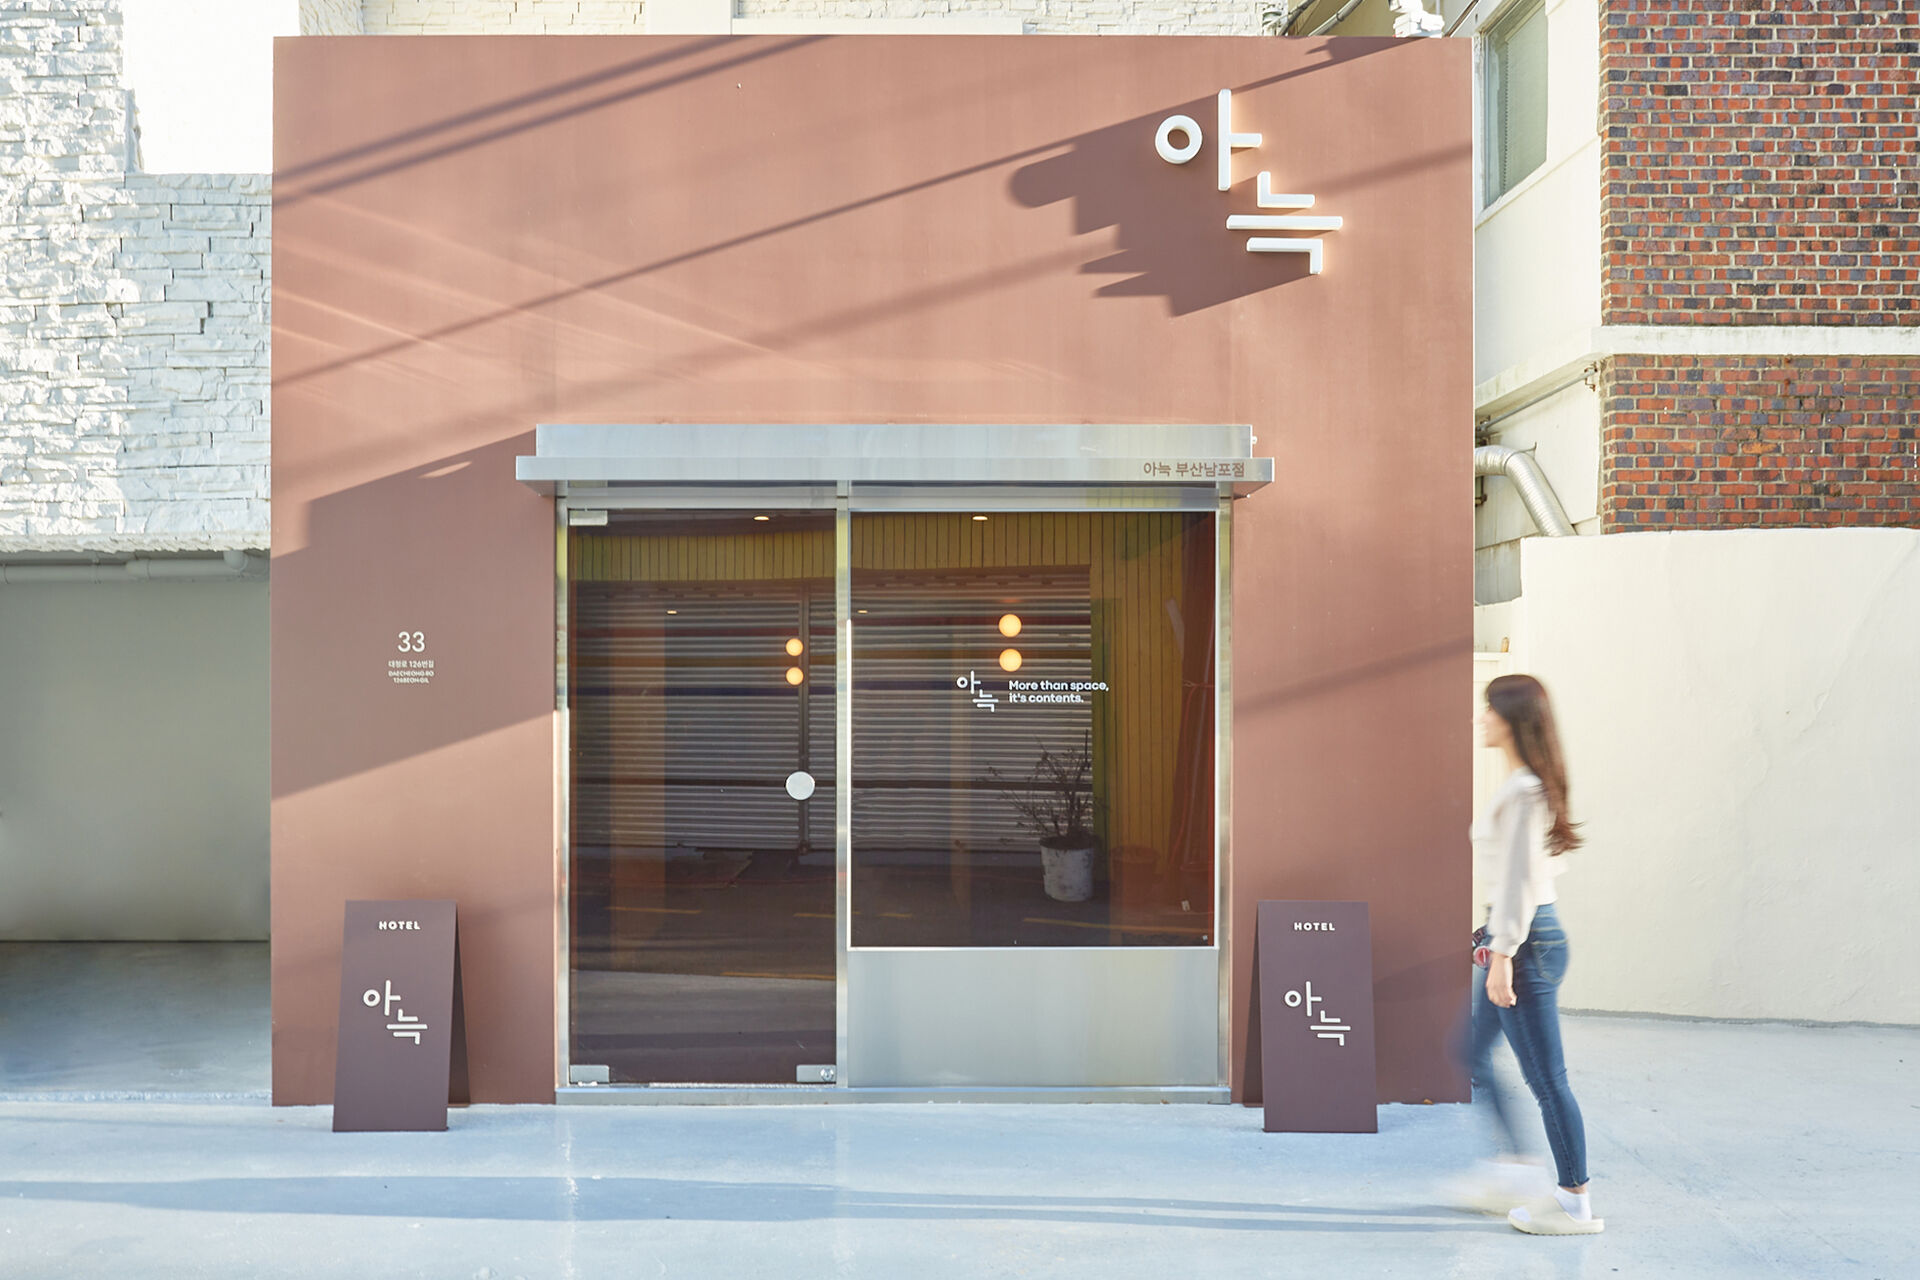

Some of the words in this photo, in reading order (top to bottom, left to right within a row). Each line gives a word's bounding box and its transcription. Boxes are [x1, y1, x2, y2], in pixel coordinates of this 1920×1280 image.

[1155, 88, 1343, 275] 아늑
[1143, 461, 1172, 477] 아늑
[1175, 461, 1246, 478] 부산남포점
[397, 630, 426, 653] 33
[956, 670, 999, 713] 아늑
[1008, 680, 1039, 691] More
[1040, 680, 1069, 691] than
[1070, 681, 1110, 693] space,
[1008, 692, 1027, 704] it's
[1028, 693, 1085, 704] contents.
[378, 920, 421, 930] HOTEL
[1293, 922, 1336, 931] HOTEL
[363, 979, 428, 1045] 아늑
[1284, 981, 1351, 1047] 아늑
